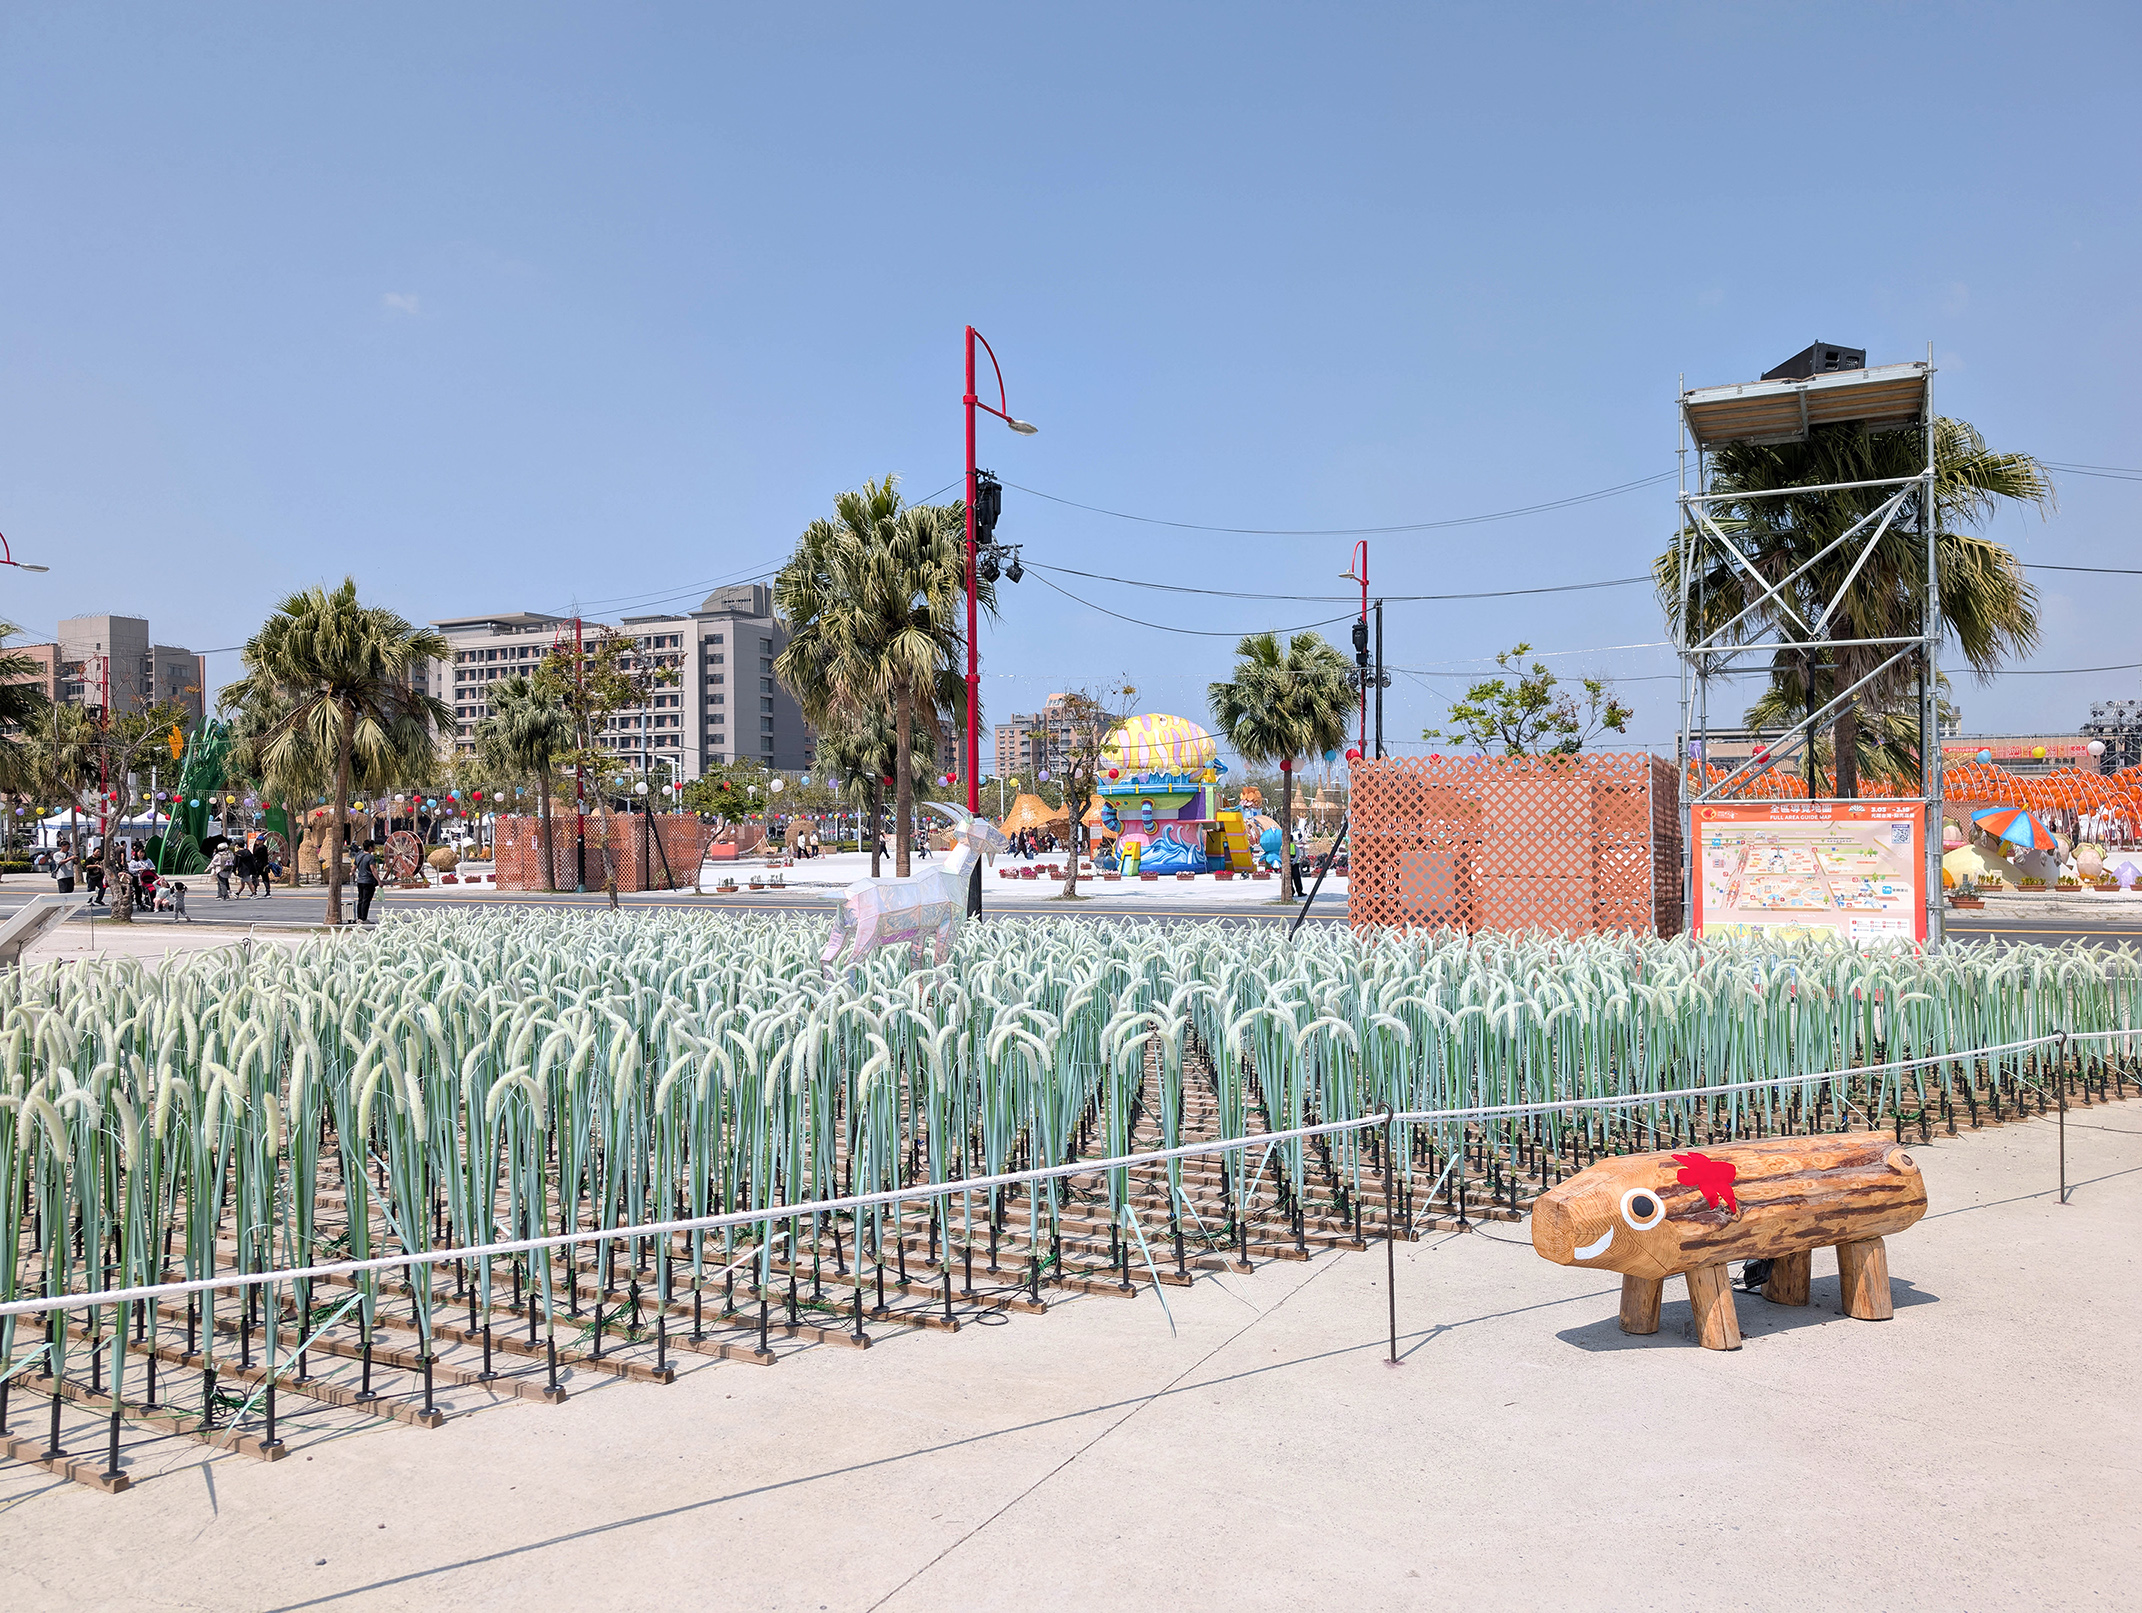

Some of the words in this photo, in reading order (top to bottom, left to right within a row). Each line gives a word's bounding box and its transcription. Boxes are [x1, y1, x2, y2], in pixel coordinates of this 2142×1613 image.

[1770, 804, 1832, 813] 全區導覽地圖
